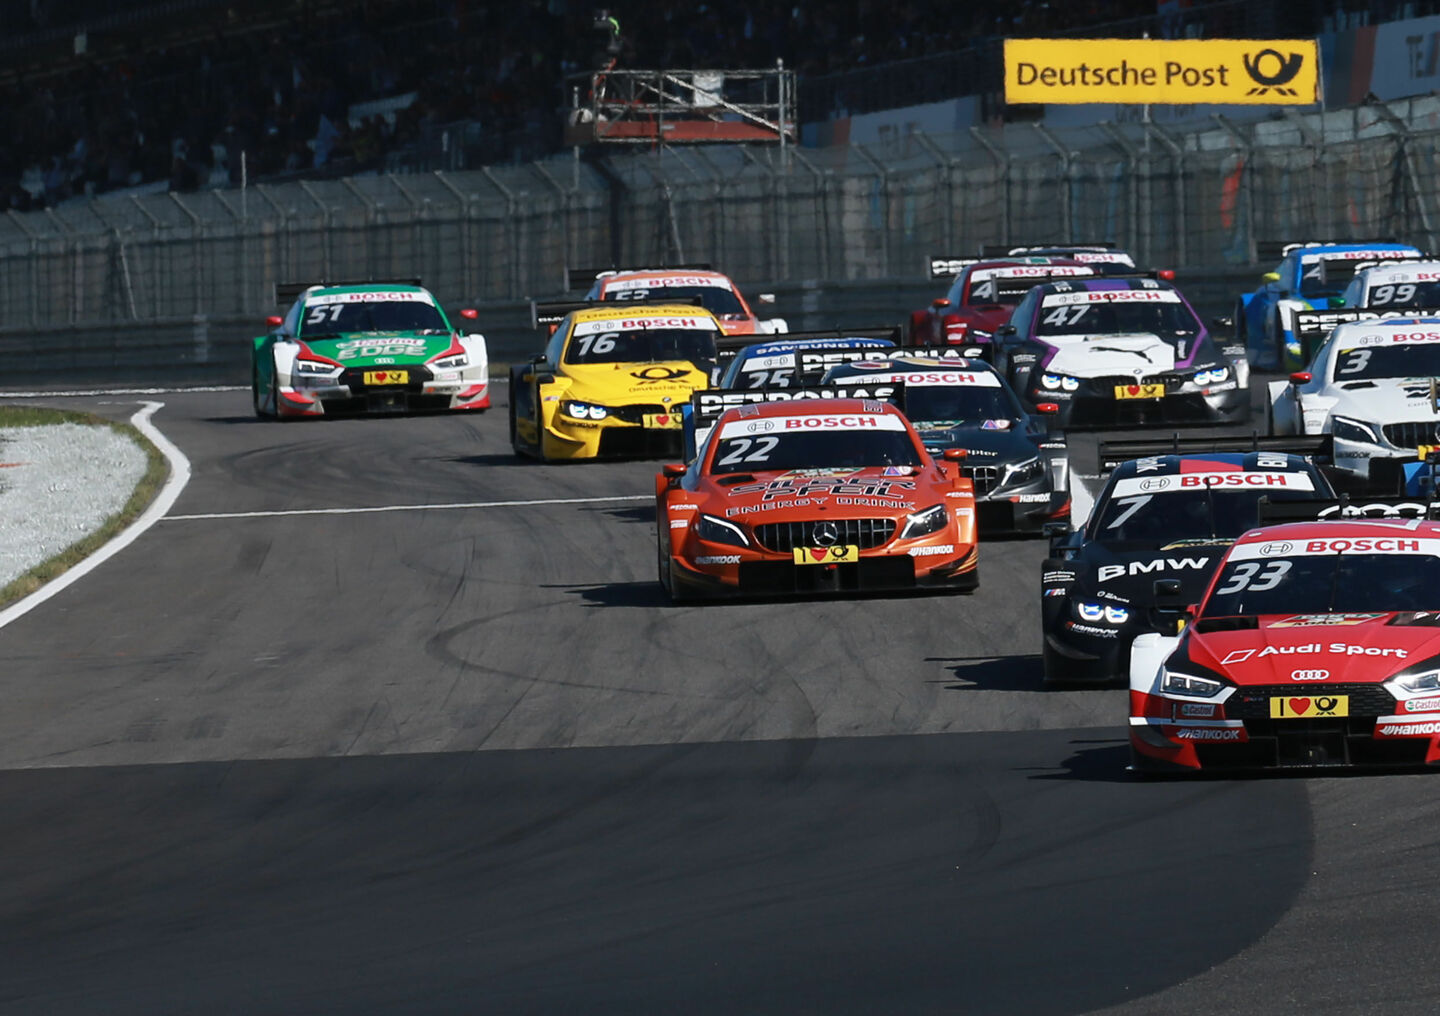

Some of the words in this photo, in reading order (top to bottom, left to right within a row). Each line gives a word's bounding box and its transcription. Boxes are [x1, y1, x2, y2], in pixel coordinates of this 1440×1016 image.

[1017, 60, 1157, 86] Deutsche
[1165, 62, 1229, 86] Post
[1012, 268, 1076, 276] BOSCH
[649, 277, 712, 286] BOSCH
[349, 293, 413, 301] BOSCH
[1088, 291, 1161, 302] BOSCH
[1371, 284, 1417, 306] 99
[306, 304, 345, 325] 51
[621, 319, 697, 328] BOSCH
[1043, 305, 1091, 327] 47
[336, 344, 428, 360] EDGE
[578, 333, 620, 356] 16
[1340, 350, 1373, 375] 3
[748, 369, 795, 387] 25
[891, 373, 976, 383] BOSCH
[785, 417, 877, 429] BOSCH
[718, 437, 780, 466] 22
[1181, 475, 1287, 487] BOSCH
[762, 484, 904, 502] PFEIL
[726, 497, 828, 518] ENERGY
[836, 497, 916, 512] DRINK
[1107, 495, 1153, 530] 7
[1305, 539, 1420, 554] BOSCH
[1098, 557, 1209, 583] BMW
[1216, 561, 1293, 595] 33
[1257, 643, 1322, 657] Audi
[1329, 643, 1408, 658] Sport
[1415, 699, 1440, 710] Castrol
